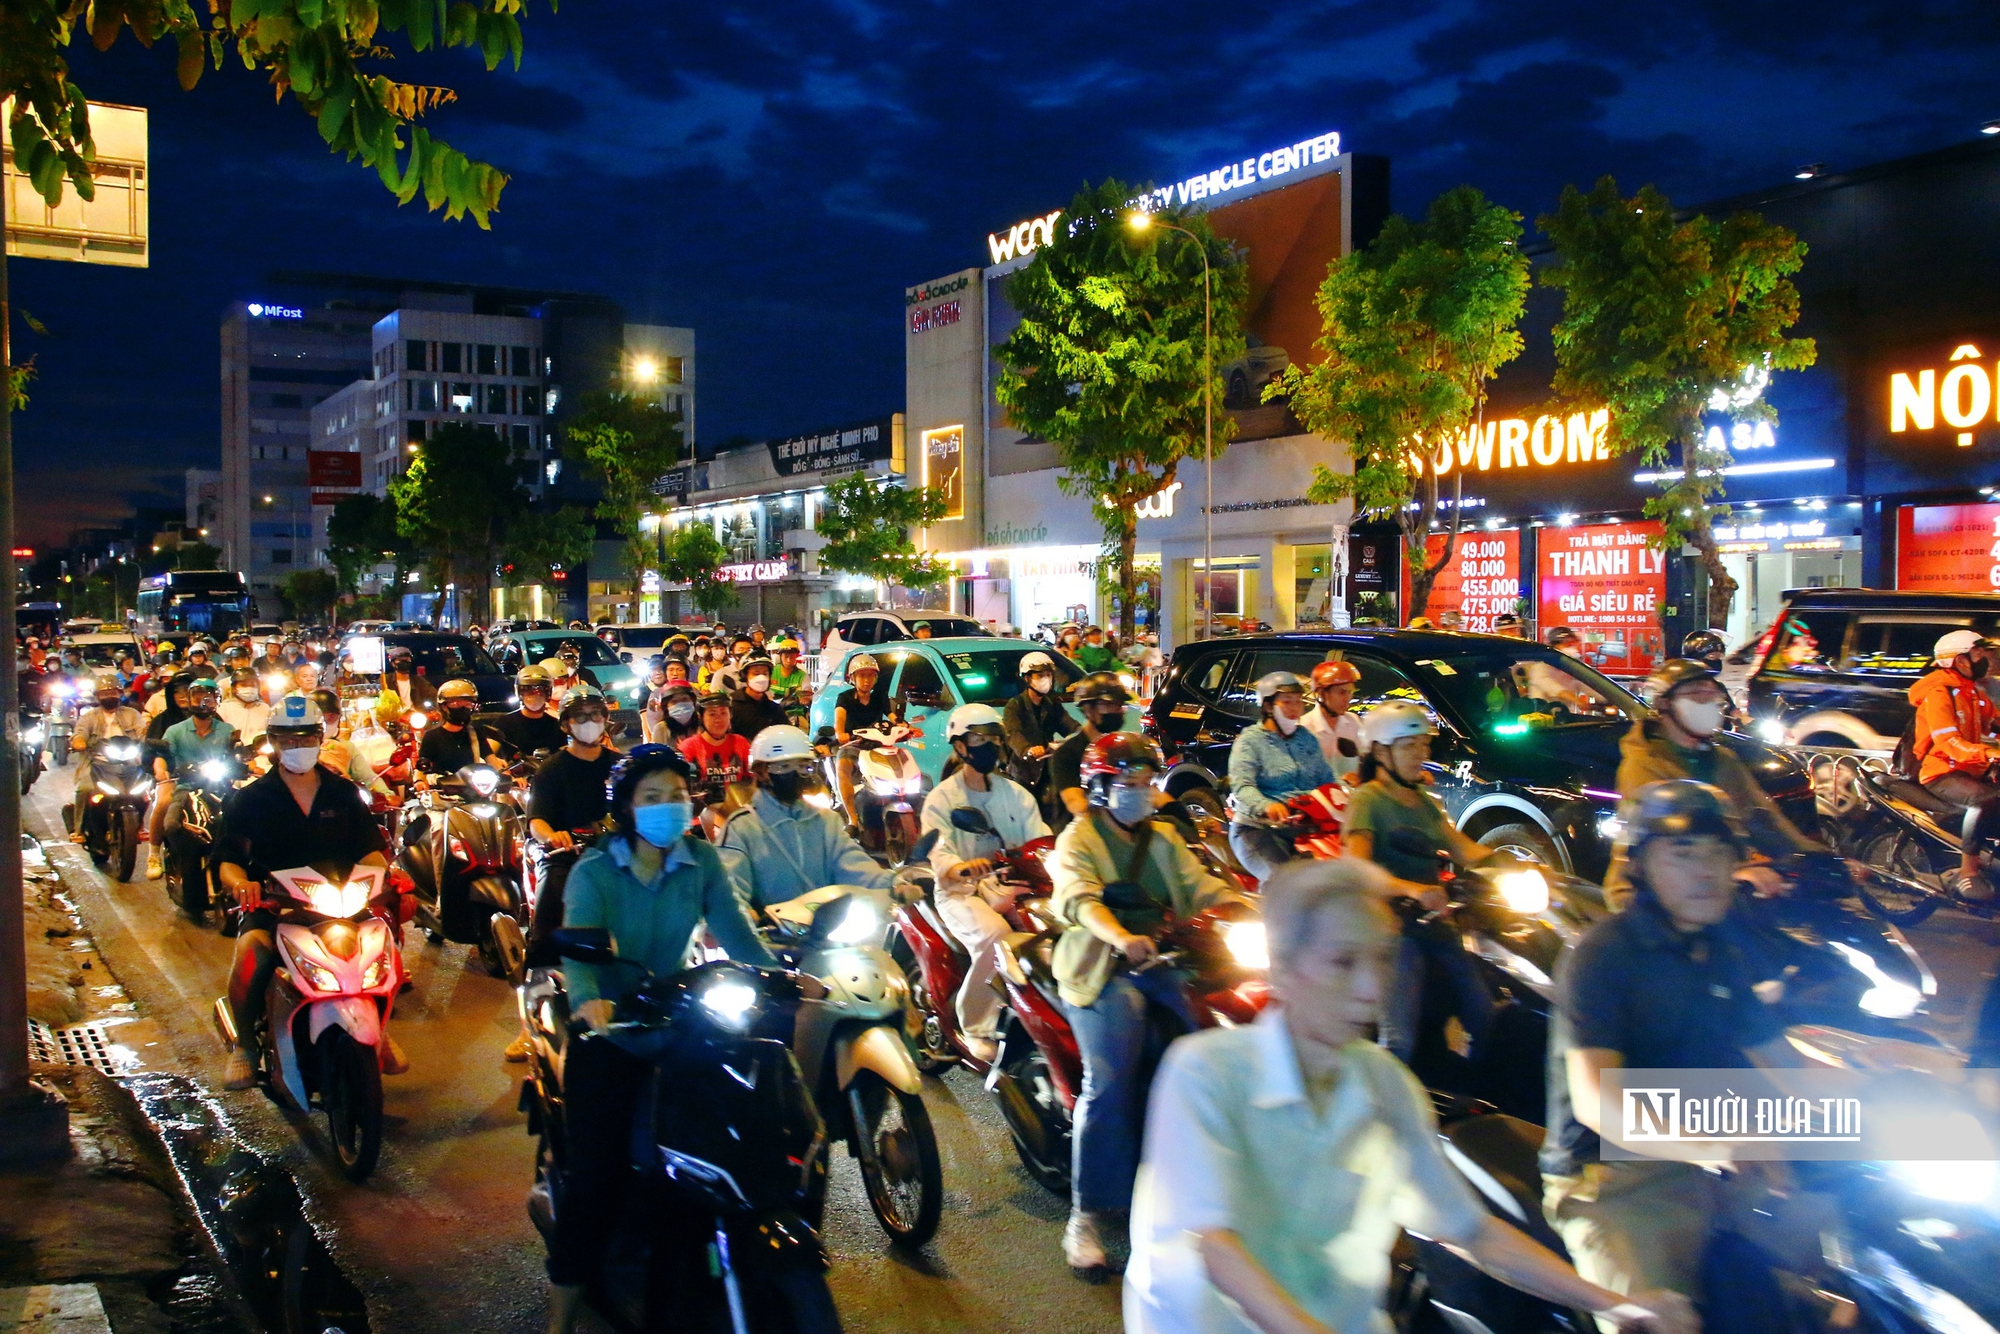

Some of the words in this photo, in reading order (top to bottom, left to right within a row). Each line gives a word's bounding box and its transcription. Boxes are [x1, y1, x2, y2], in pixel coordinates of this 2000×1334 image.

[1177, 157, 1255, 205] VEHICLE
[1257, 131, 1340, 179] CENTER
[1891, 344, 2000, 446] NỘ
[842, 428, 861, 448] MINH
[1569, 533, 1589, 547] TRẢ
[1591, 533, 1614, 548] MẶT
[1617, 530, 1646, 545] BẰNG
[1461, 541, 1506, 559] 49.000
[1549, 549, 1629, 576] THANH
[1639, 541, 1666, 574] LÝ
[755, 562, 788, 580] CARS
[1461, 559, 1506, 577] 80.000
[1461, 578, 1519, 596] 455.000
[1559, 590, 1586, 612] GIÁ
[1590, 589, 1628, 612] SIÊU
[1633, 587, 1656, 612] RẺ
[1567, 615, 1597, 623] HOTLINE:
[1598, 615, 1615, 623] 1900
[1616, 615, 1626, 623] 54
[1626, 615, 1636, 623] 54
[1637, 615, 1646, 623] 84
[706, 766, 741, 775] CALEM
[711, 774, 737, 783] CLUB
